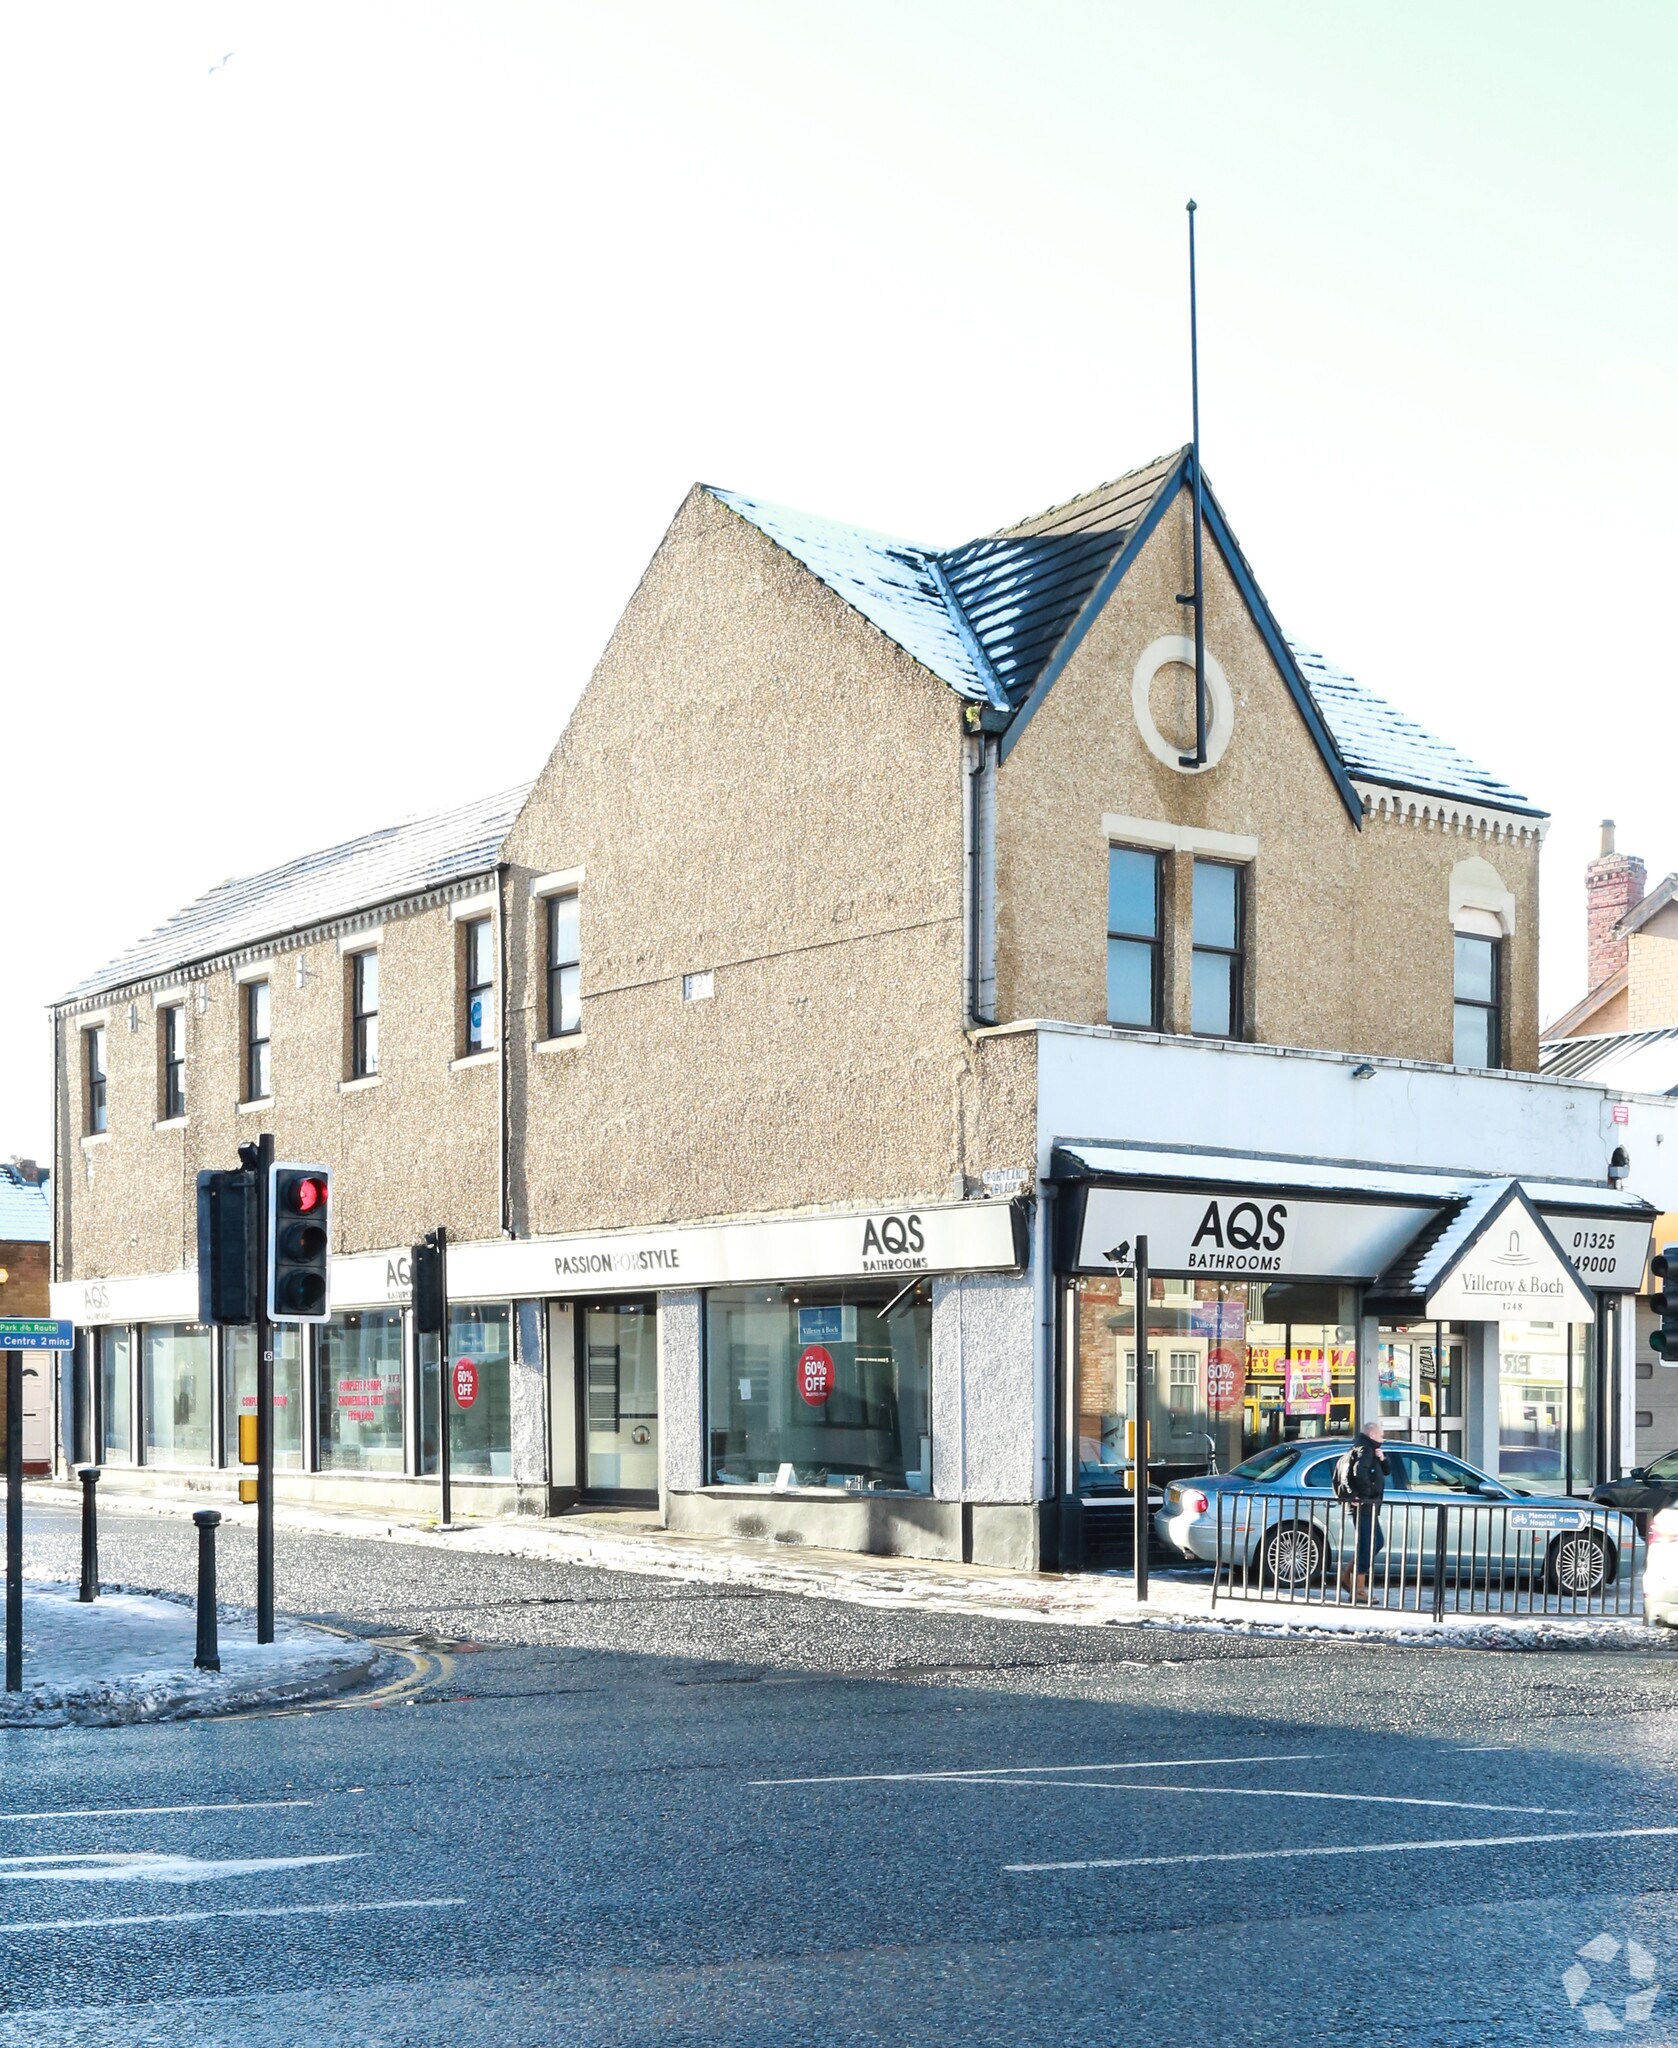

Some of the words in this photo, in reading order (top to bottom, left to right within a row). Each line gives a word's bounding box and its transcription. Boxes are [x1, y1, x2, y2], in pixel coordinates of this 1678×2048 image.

[1191, 1200, 1288, 1251] AQS
[862, 1214, 925, 1256] AQS
[1573, 1231, 1616, 1250] 01325
[863, 1257, 928, 1271] BATHROOMS
[1188, 1253, 1282, 1271] BATHROOMS
[1568, 1255, 1617, 1273] 49000
[386, 1257, 412, 1287] AQ
[1462, 1273, 1515, 1296] Villeroy
[1518, 1278, 1528, 1292] &
[1530, 1276, 1564, 1294] Boch
[84, 1285, 110, 1310] AQS
[1502, 1302, 1523, 1311] 1748
[0, 1324, 17, 1332] Park
[34, 1324, 57, 1332] Route
[4, 1336, 37, 1346] Centre
[41, 1337, 47, 1346] 2
[48, 1337, 70, 1346] mins
[265, 1352, 272, 1360] 6
[805, 1361, 827, 1376] 60%
[1208, 1363, 1235, 1379] 60%
[457, 1370, 474, 1383] 60%
[805, 1376, 826, 1391] OFF
[457, 1383, 473, 1396] OFF
[1208, 1380, 1233, 1396] OFF
[1528, 1512, 1557, 1520] Memorial
[1529, 1519, 1556, 1527] Hospital
[1564, 1516, 1579, 1524] mins
